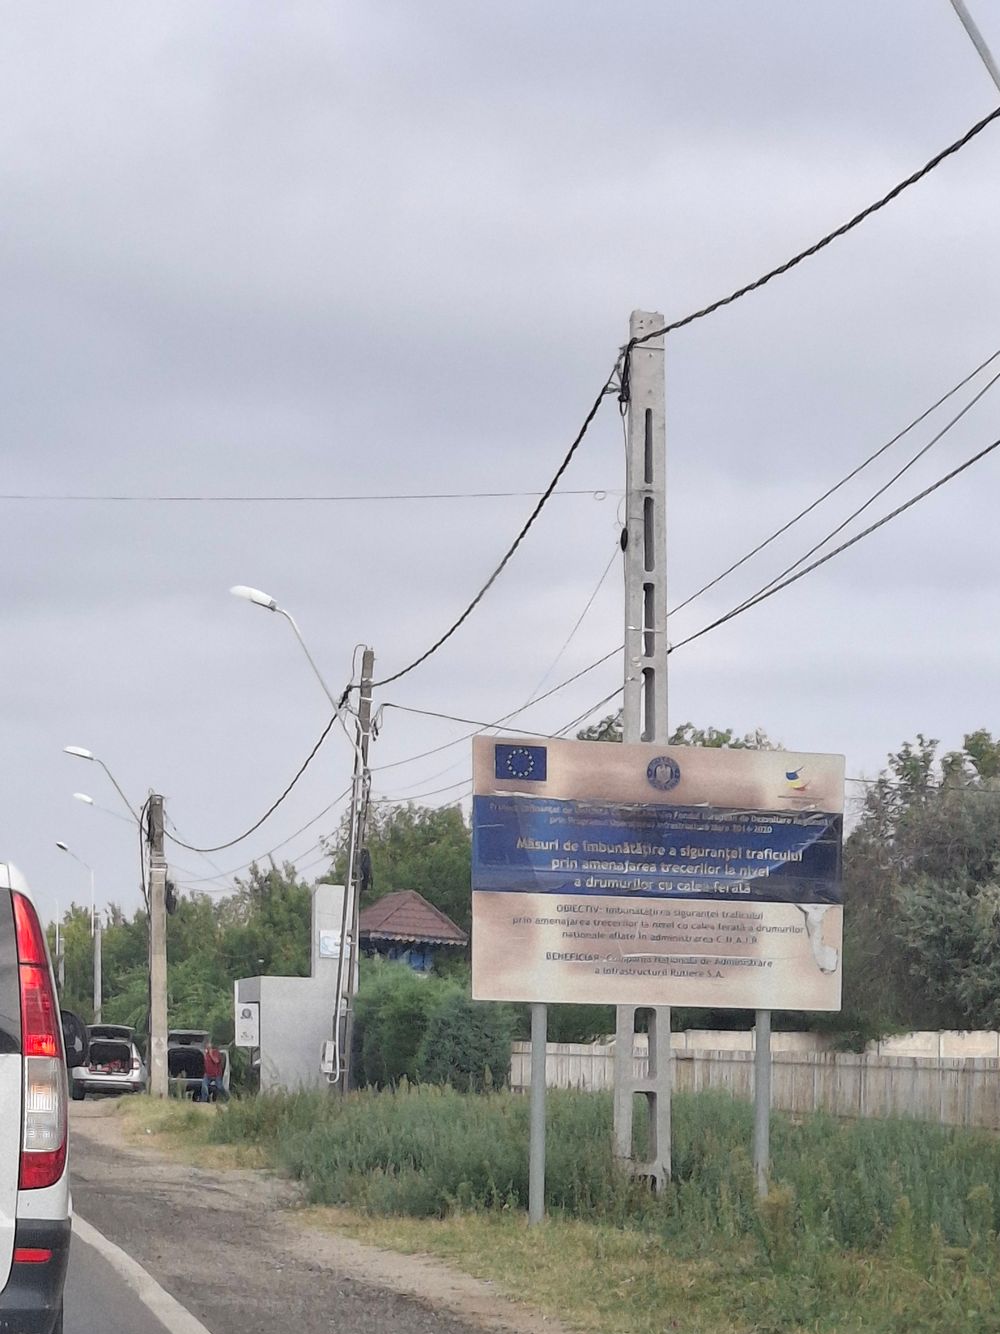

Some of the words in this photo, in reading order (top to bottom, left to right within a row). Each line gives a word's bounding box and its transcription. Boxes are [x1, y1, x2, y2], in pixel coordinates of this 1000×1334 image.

[563, 841, 579, 852] de
[669, 846, 677, 857] a
[746, 848, 803, 862] traficului
[551, 856, 578, 871] prin
[582, 859, 657, 873] amenajarea
[661, 862, 721, 875] trecerilor
[725, 864, 736, 876] la
[739, 865, 770, 878] nivel
[574, 878, 582, 888] a
[585, 875, 654, 891] drumurilor
[658, 881, 673, 892] cu
[535, 916, 591, 928] amenajarea
[755, 924, 805, 934] drumurilor
